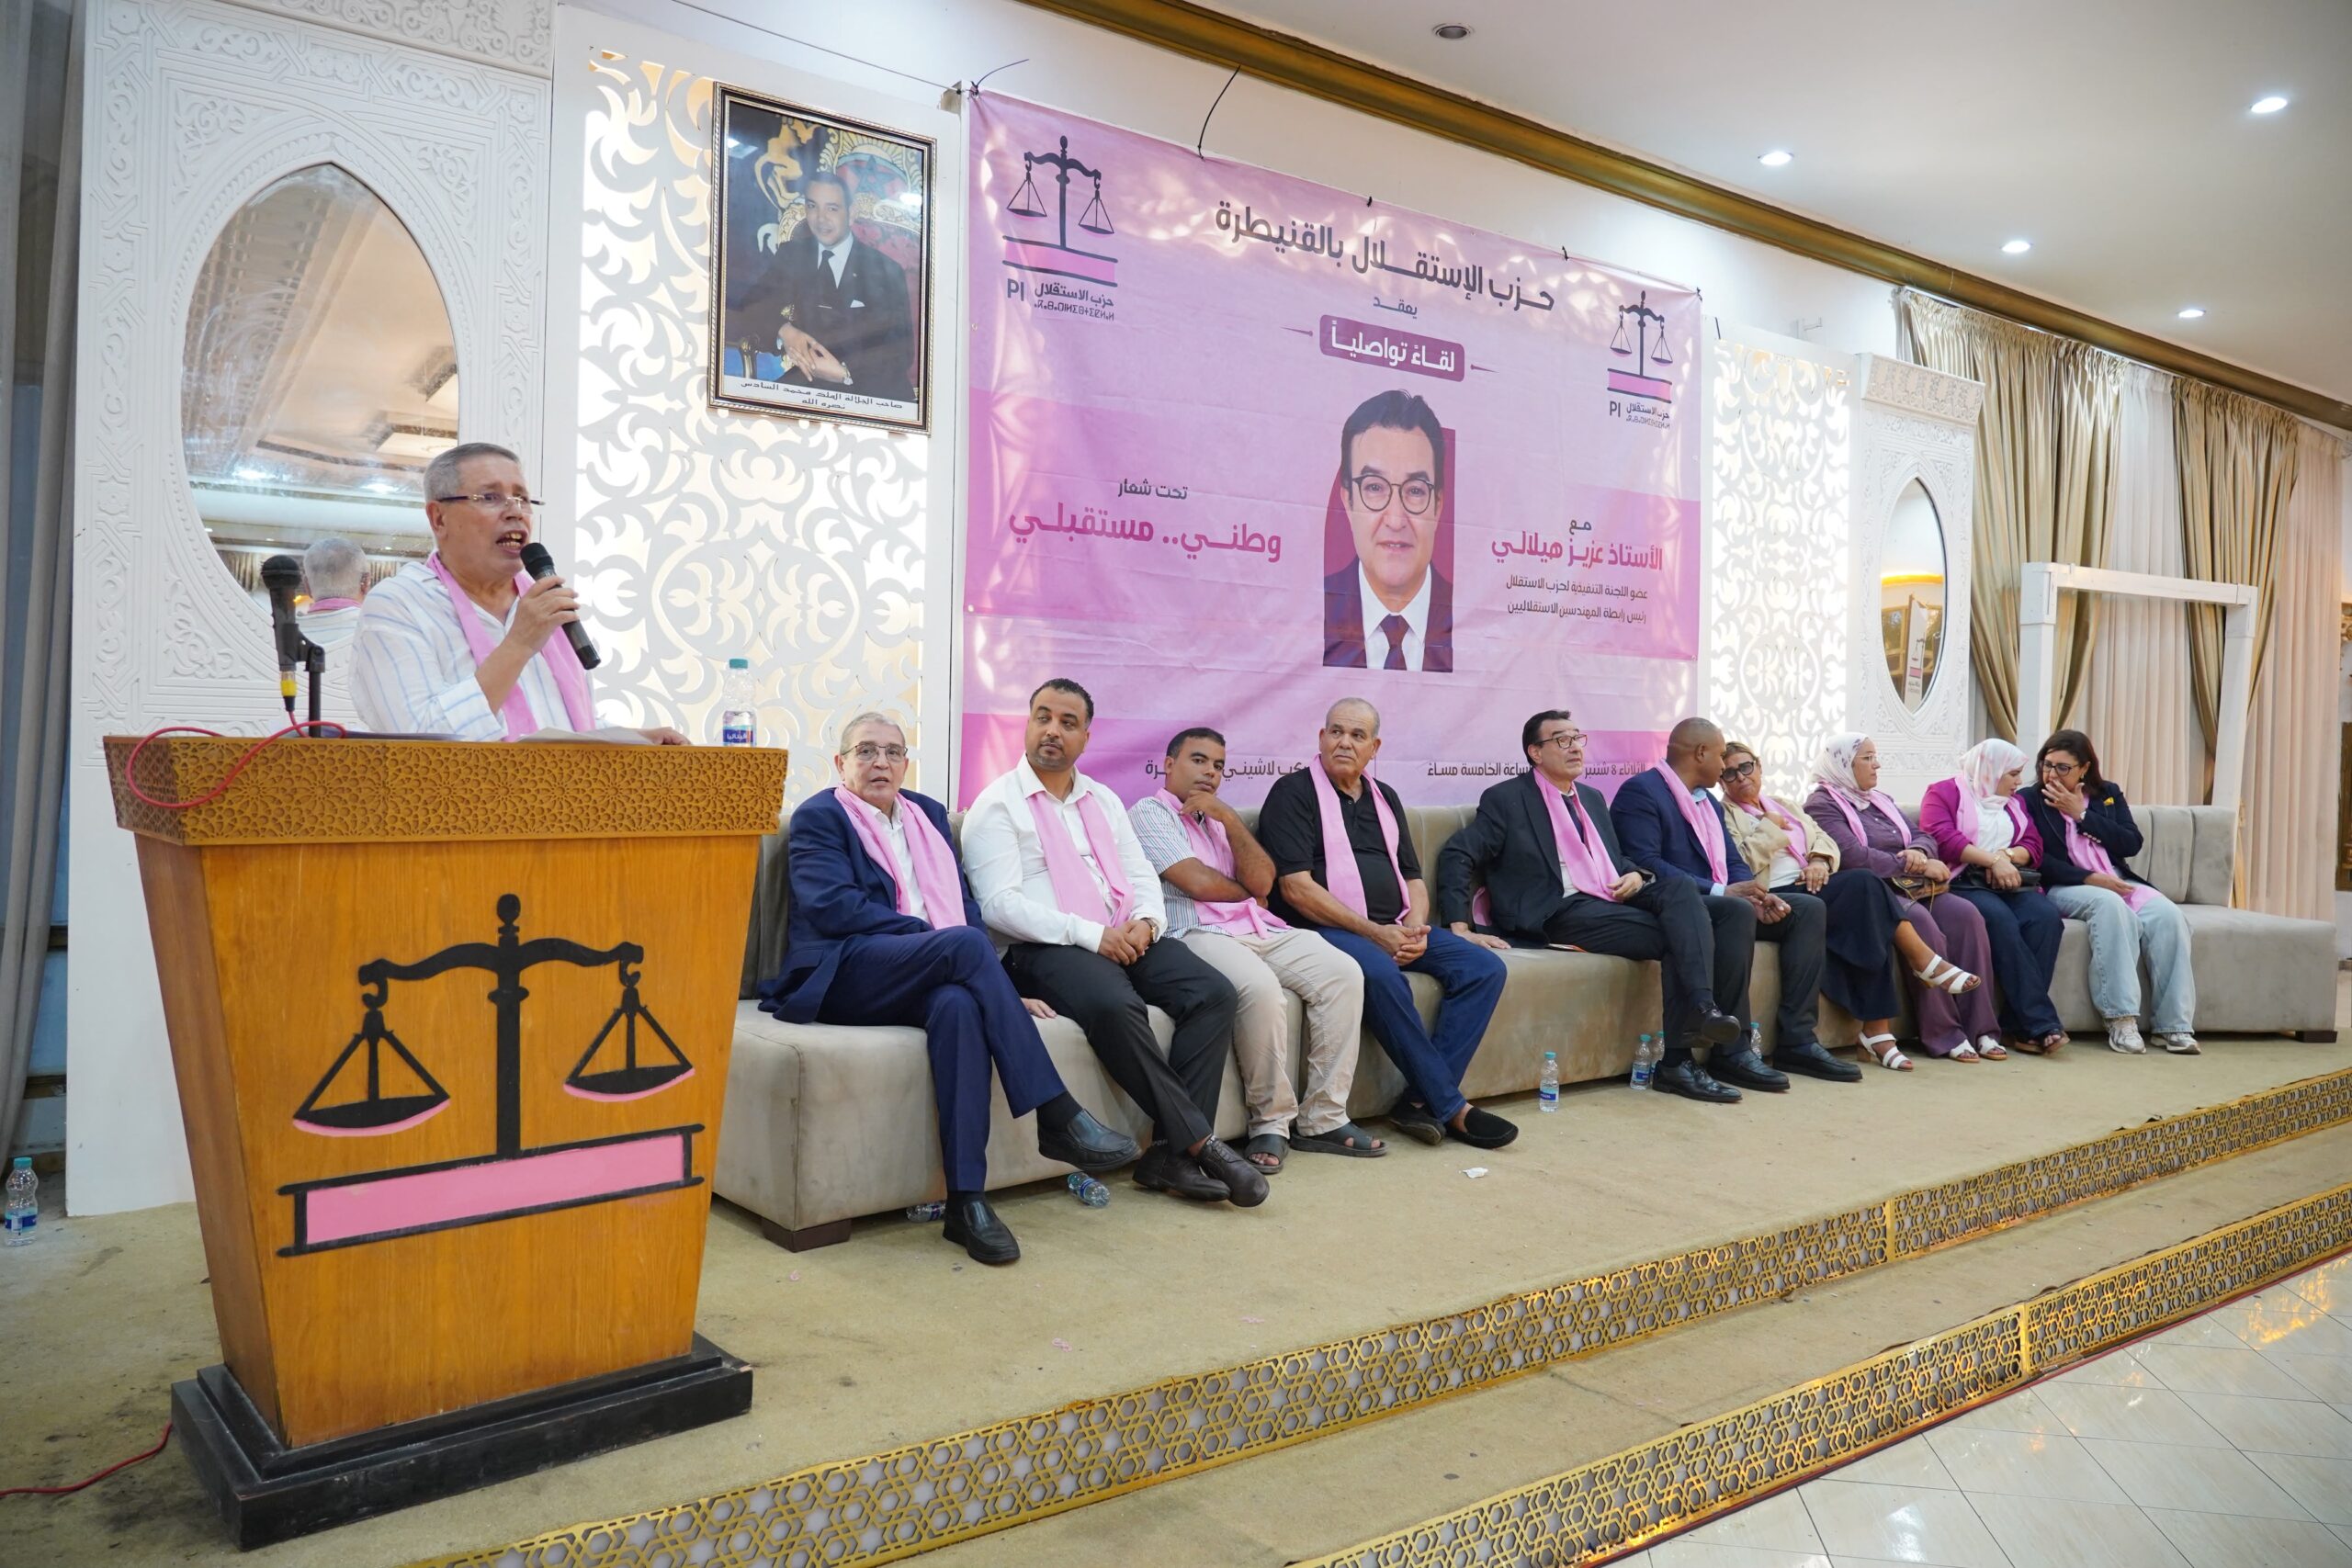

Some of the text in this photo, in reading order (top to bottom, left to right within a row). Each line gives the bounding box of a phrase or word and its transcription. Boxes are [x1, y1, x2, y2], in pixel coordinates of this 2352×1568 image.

[1215, 200, 1555, 311] حزب الإستقلال بالقنيطرة
[1007, 278, 1024, 302] PI
[1035, 282, 1114, 309] حزب الاستقلال
[1373, 296, 1418, 320] يعقد
[1610, 400, 1621, 417] PI
[1117, 478, 1188, 501] تحت شعار
[1008, 502, 1154, 545] مستقبلي
[1569, 519, 1592, 536] مع
[1491, 530, 1663, 571] الأستاذ عزيز هيلالي
[1506, 573, 1648, 602] عضو اللجنة التنفيذية لحزب الاستقلال
[1508, 600, 1558, 615] الاستقلاليين
[1602, 606, 1625, 623] رابطة
[1626, 610, 1647, 625] رئيس
[1461, 761, 1501, 776] الخامسة
[1611, 763, 1617, 776] 8
